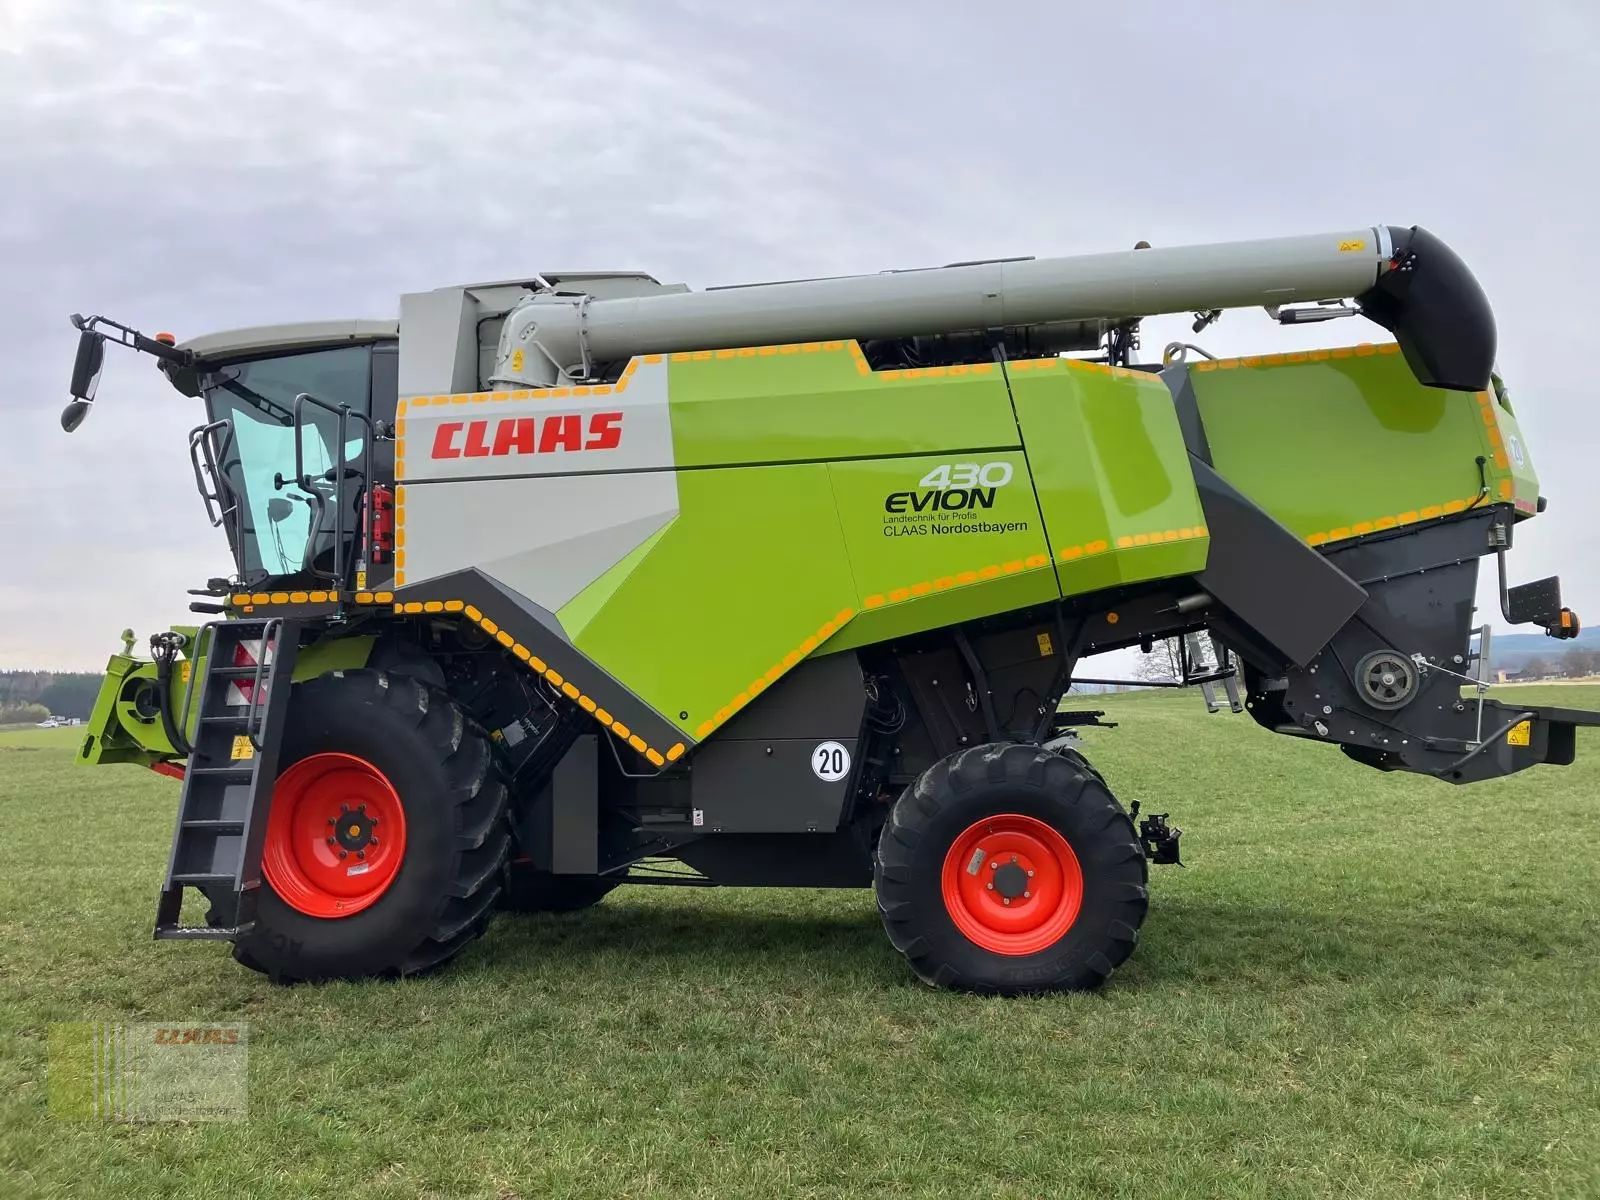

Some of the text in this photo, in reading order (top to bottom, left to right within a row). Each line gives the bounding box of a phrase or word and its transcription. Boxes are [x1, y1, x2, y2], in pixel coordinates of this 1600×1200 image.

[431, 412, 624, 459] CLAAS
[919, 461, 1013, 489] 430
[885, 487, 996, 513] EVION
[883, 511, 977, 523] Landtechnik für Profis
[883, 521, 1028, 537] CLAAS Nordostbayern
[819, 748, 843, 774] 20
